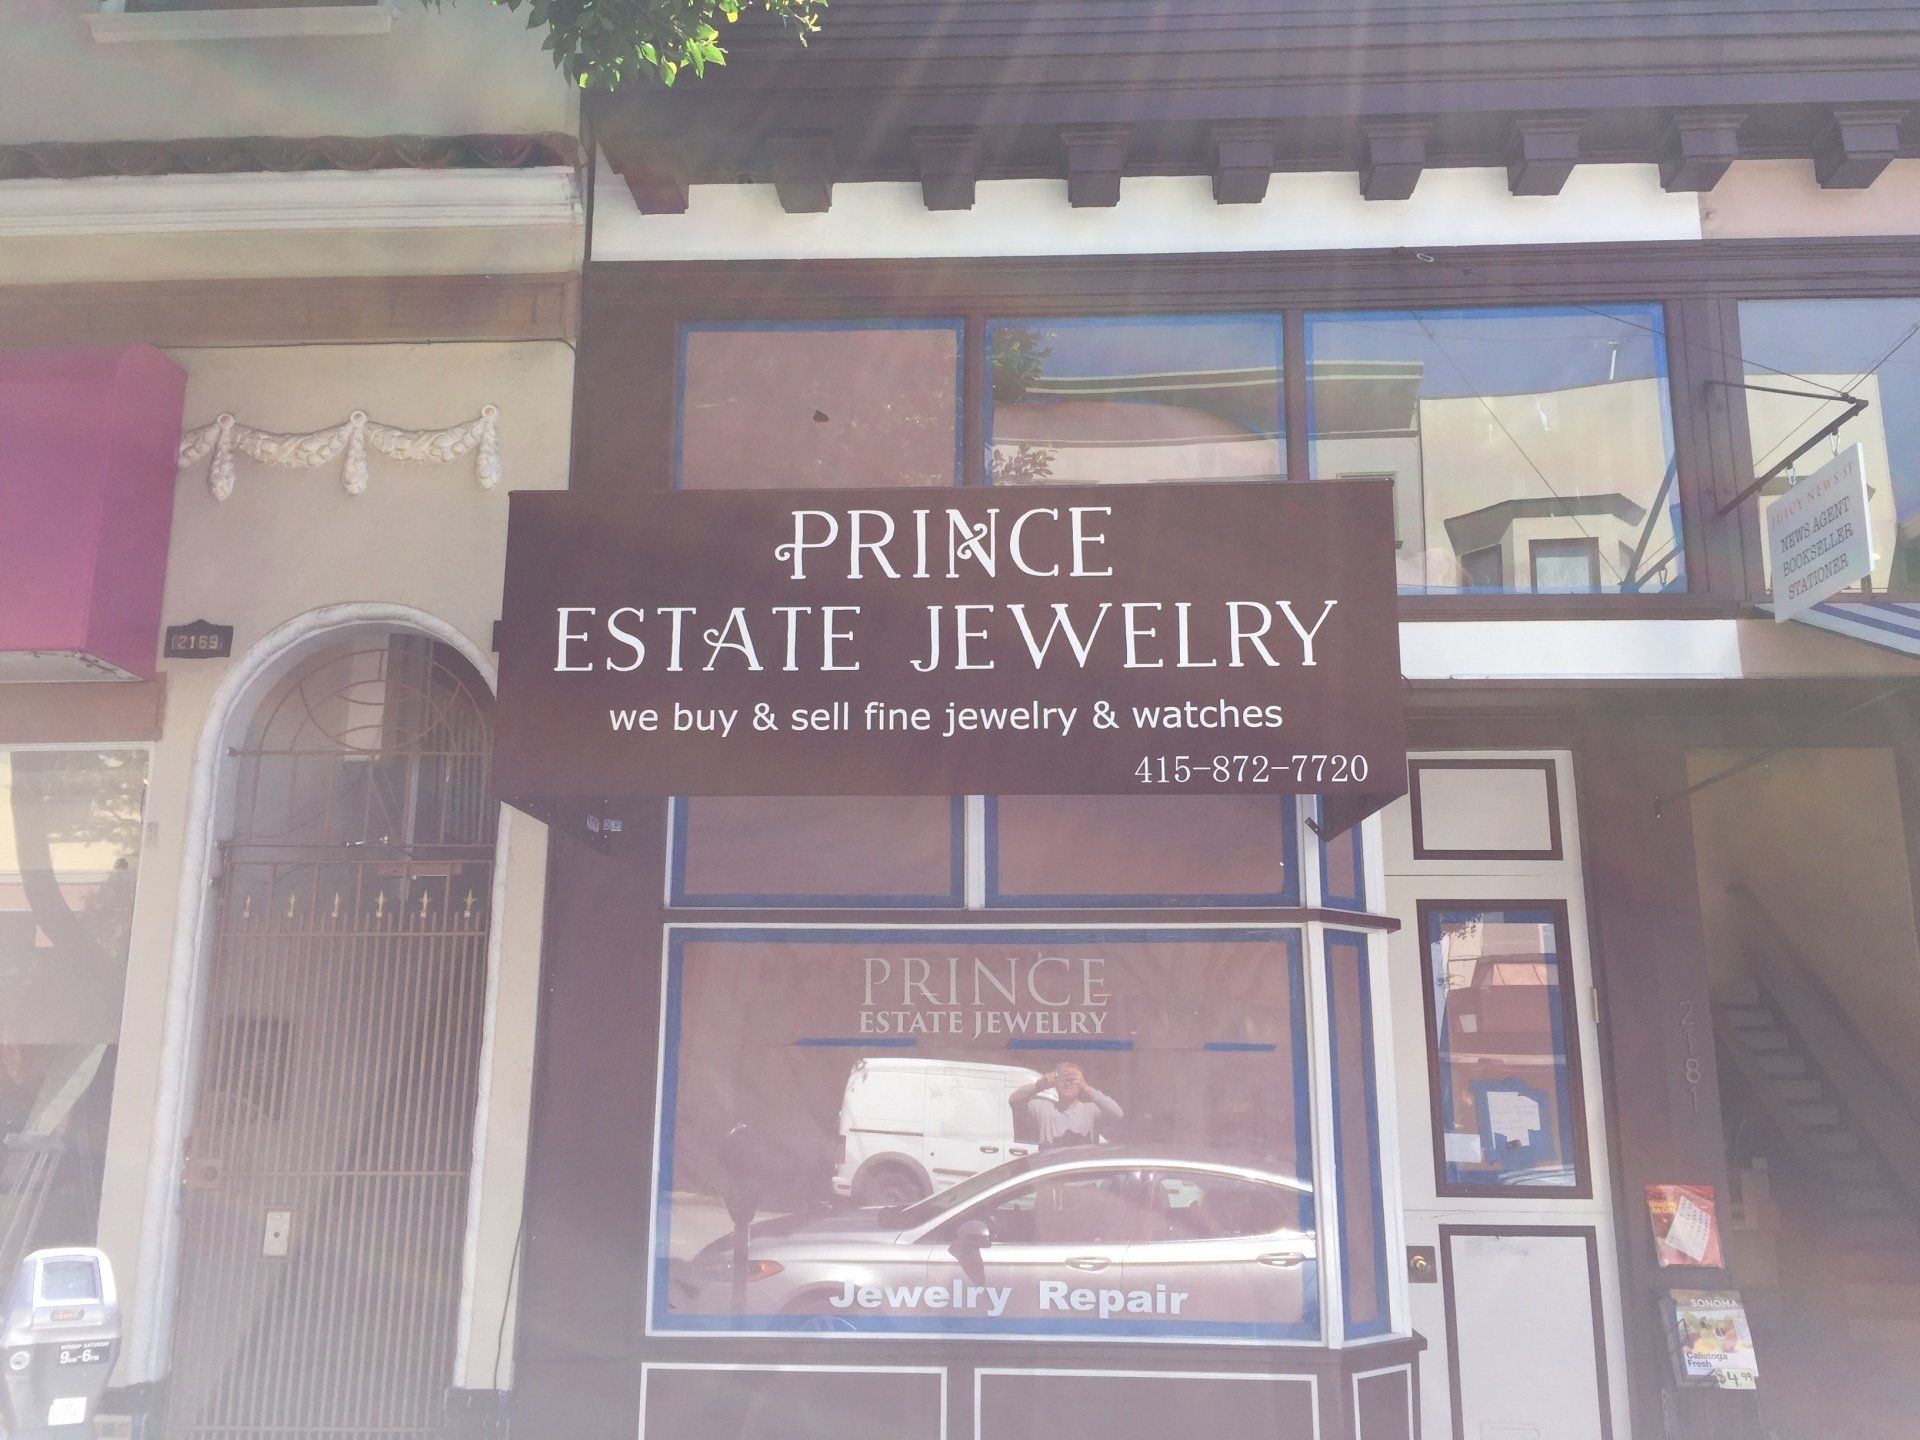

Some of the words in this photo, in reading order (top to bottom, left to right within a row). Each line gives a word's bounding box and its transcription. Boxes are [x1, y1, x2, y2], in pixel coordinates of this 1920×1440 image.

[1807, 475, 1839, 504] NEWS
[774, 506, 1114, 581] PRINCE
[1780, 522, 1815, 553] NEWS
[1812, 496, 1850, 534] AGENT
[1783, 522, 1854, 578] BOOKSELLER
[1788, 553, 1849, 600] STATIONER
[178, 635, 218, 649] 2169
[553, 605, 862, 673] ESTATE
[909, 599, 1338, 674] JEWELRY
[609, 709, 660, 732] we
[673, 702, 738, 738] buy
[752, 702, 779, 732] &
[791, 701, 849, 732] sell
[864, 701, 931, 731] fine
[942, 700, 1078, 738] jewelry
[1092, 700, 1120, 731] &
[1131, 698, 1283, 730] watches
[1134, 754, 1369, 785] 415-872-7720
[860, 957, 1108, 1007] PRINCE
[859, 1011, 963, 1033] ESTATE
[971, 1011, 1108, 1039] JEWELRY
[829, 1279, 1012, 1317] Jewelry
[1039, 1280, 1189, 1319] Repair
[1691, 1298, 1739, 1308] SONOMA
[1687, 1360, 1712, 1368] Fresh
[1716, 1368, 1753, 1387] $4.99
